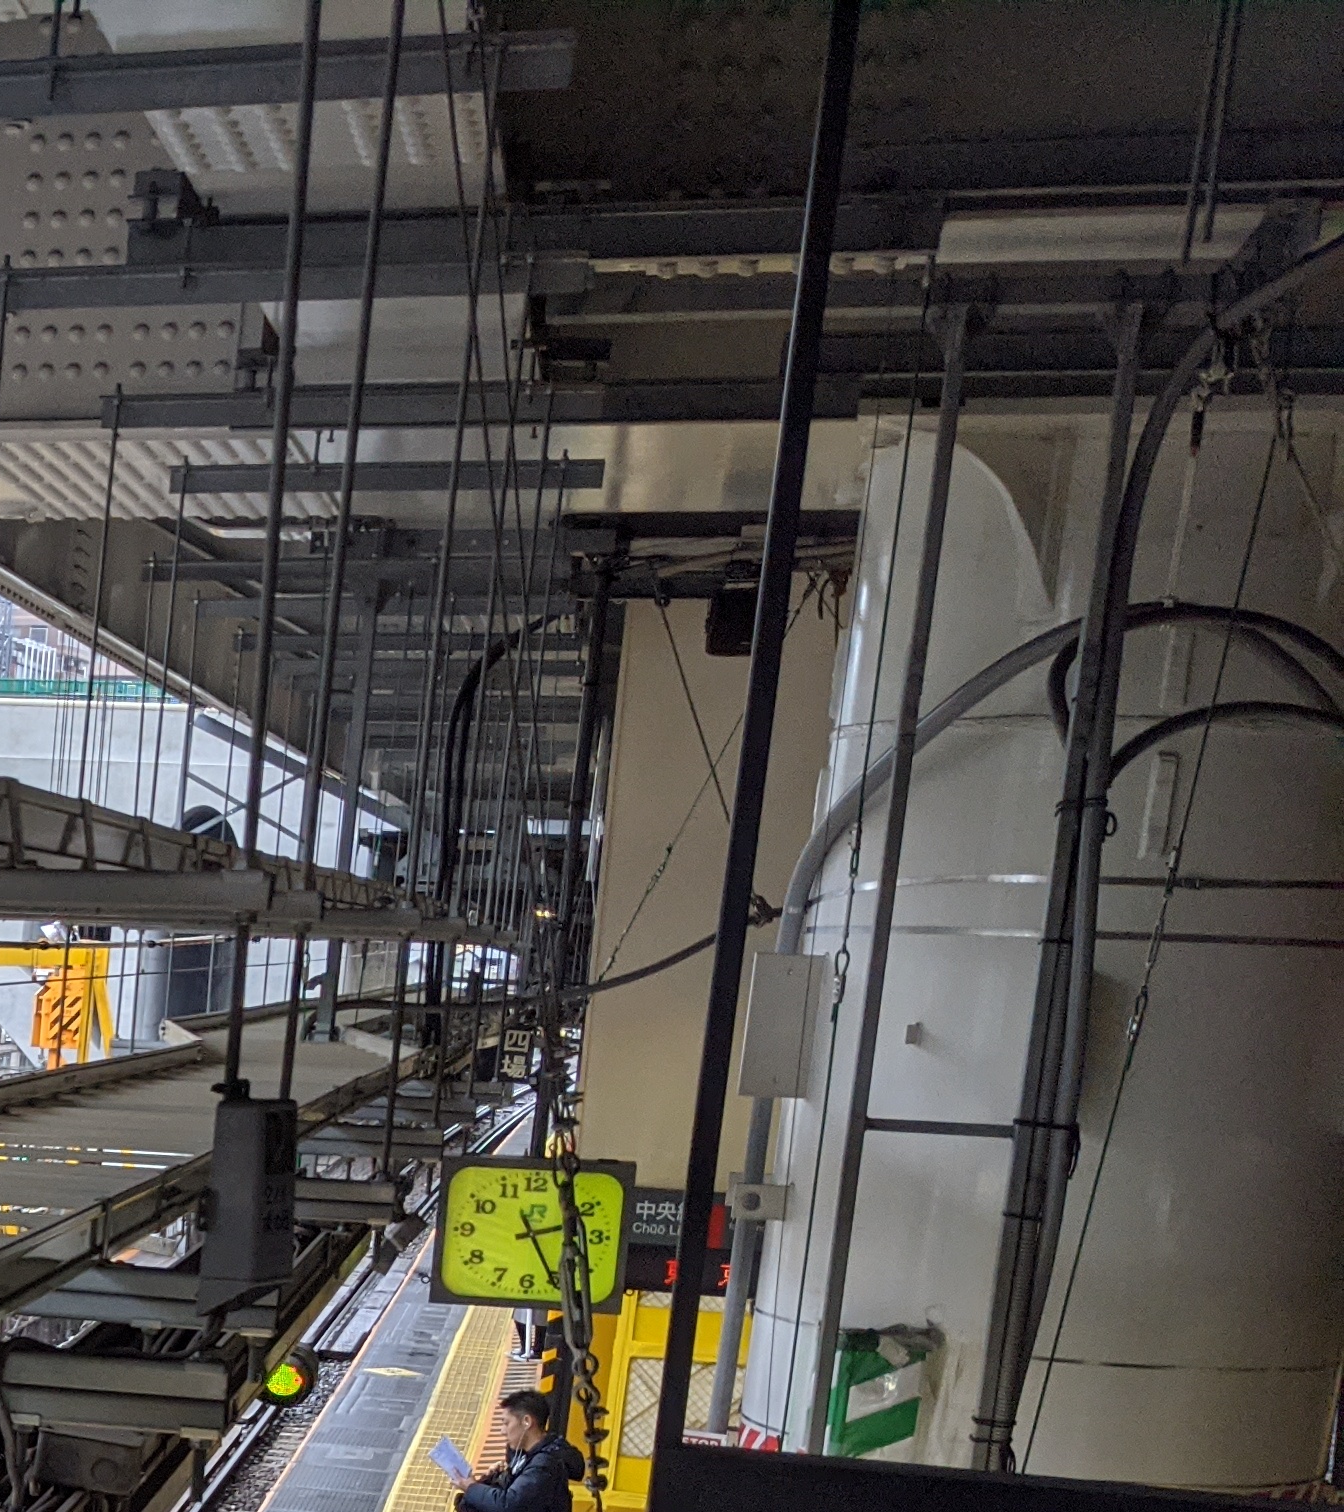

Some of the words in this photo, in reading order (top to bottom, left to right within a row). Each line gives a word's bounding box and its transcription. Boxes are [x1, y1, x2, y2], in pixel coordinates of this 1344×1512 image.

[499, 1182, 520, 1199] 11
[524, 1177, 548, 1193] 12
[474, 1199, 496, 1215] 10
[459, 1221, 475, 1239] 9
[588, 1229, 605, 1246] 3
[469, 1248, 485, 1265] 8
[493, 1267, 509, 1283] 7
[519, 1273, 535, 1289] 6
